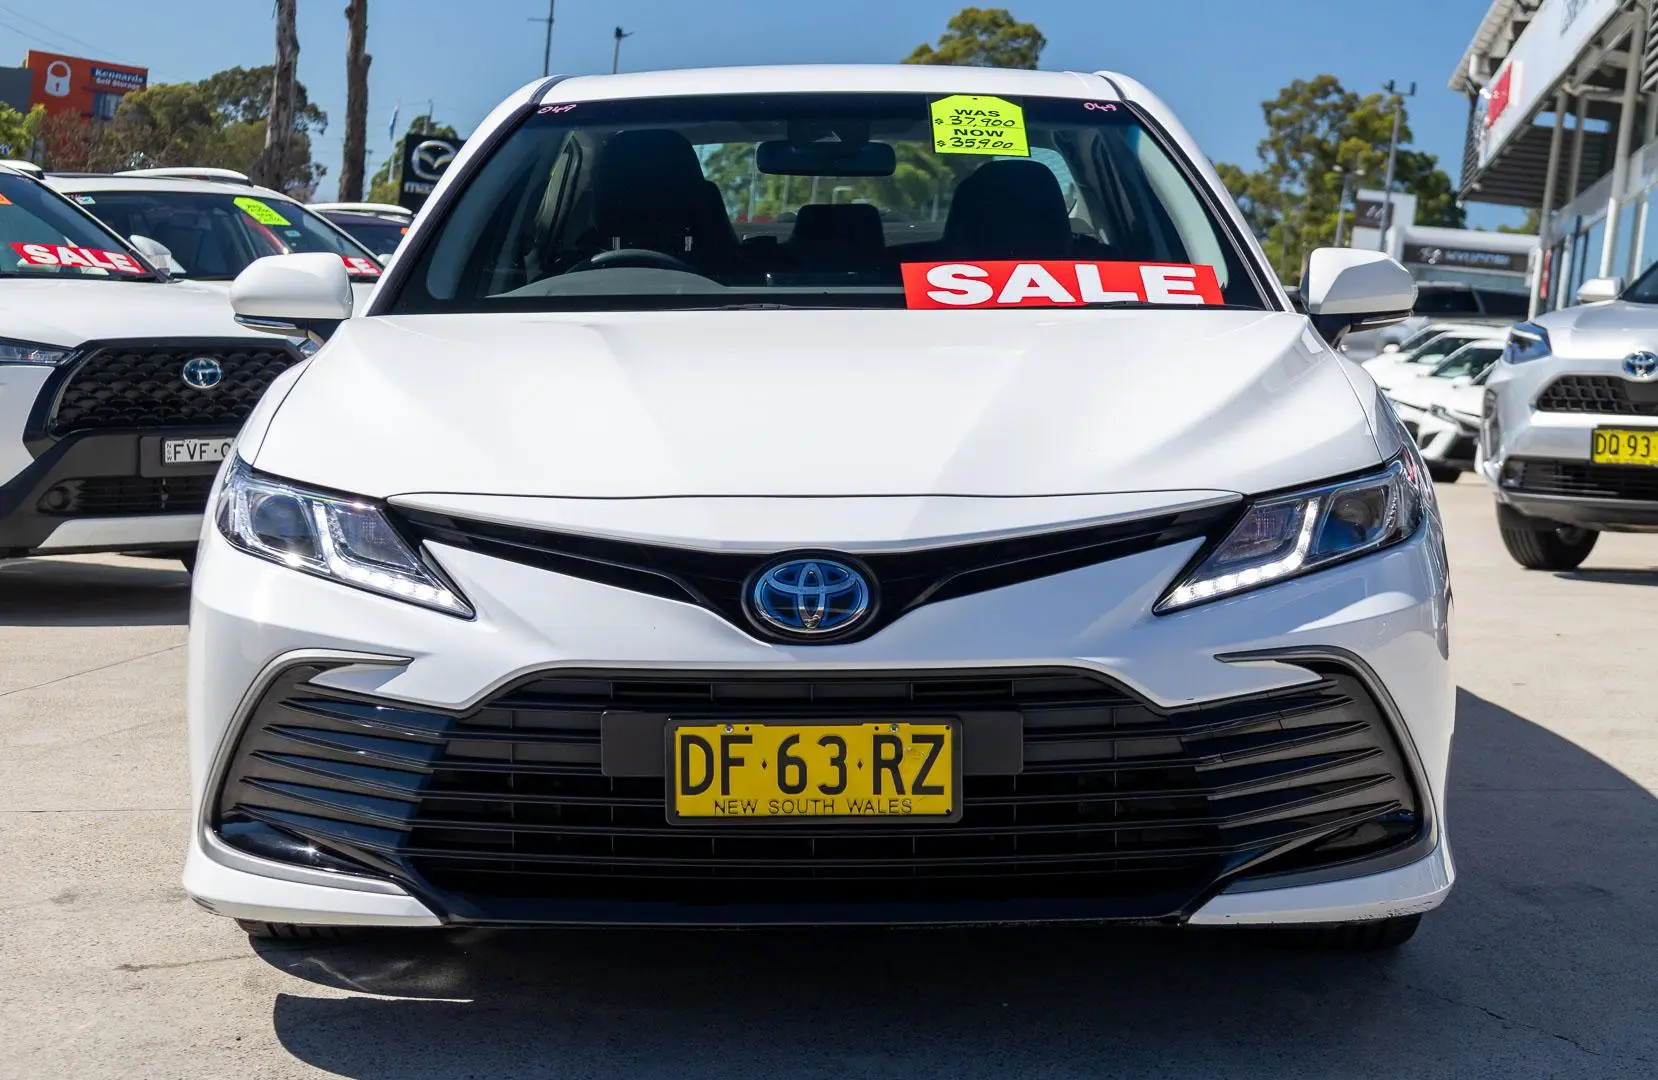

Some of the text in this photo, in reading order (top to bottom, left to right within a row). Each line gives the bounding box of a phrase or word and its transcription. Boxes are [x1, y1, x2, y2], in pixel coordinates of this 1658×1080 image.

[95, 68, 144, 83] Kennards
[954, 109, 1001, 117] WAS
[949, 115, 1015, 127] 37,900
[953, 129, 1004, 137] NOW
[949, 137, 1014, 149] 35,900
[22, 244, 141, 274] SALE
[926, 263, 1205, 305] SALE
[713, 799, 913, 815] NEW SOUTH WALES
